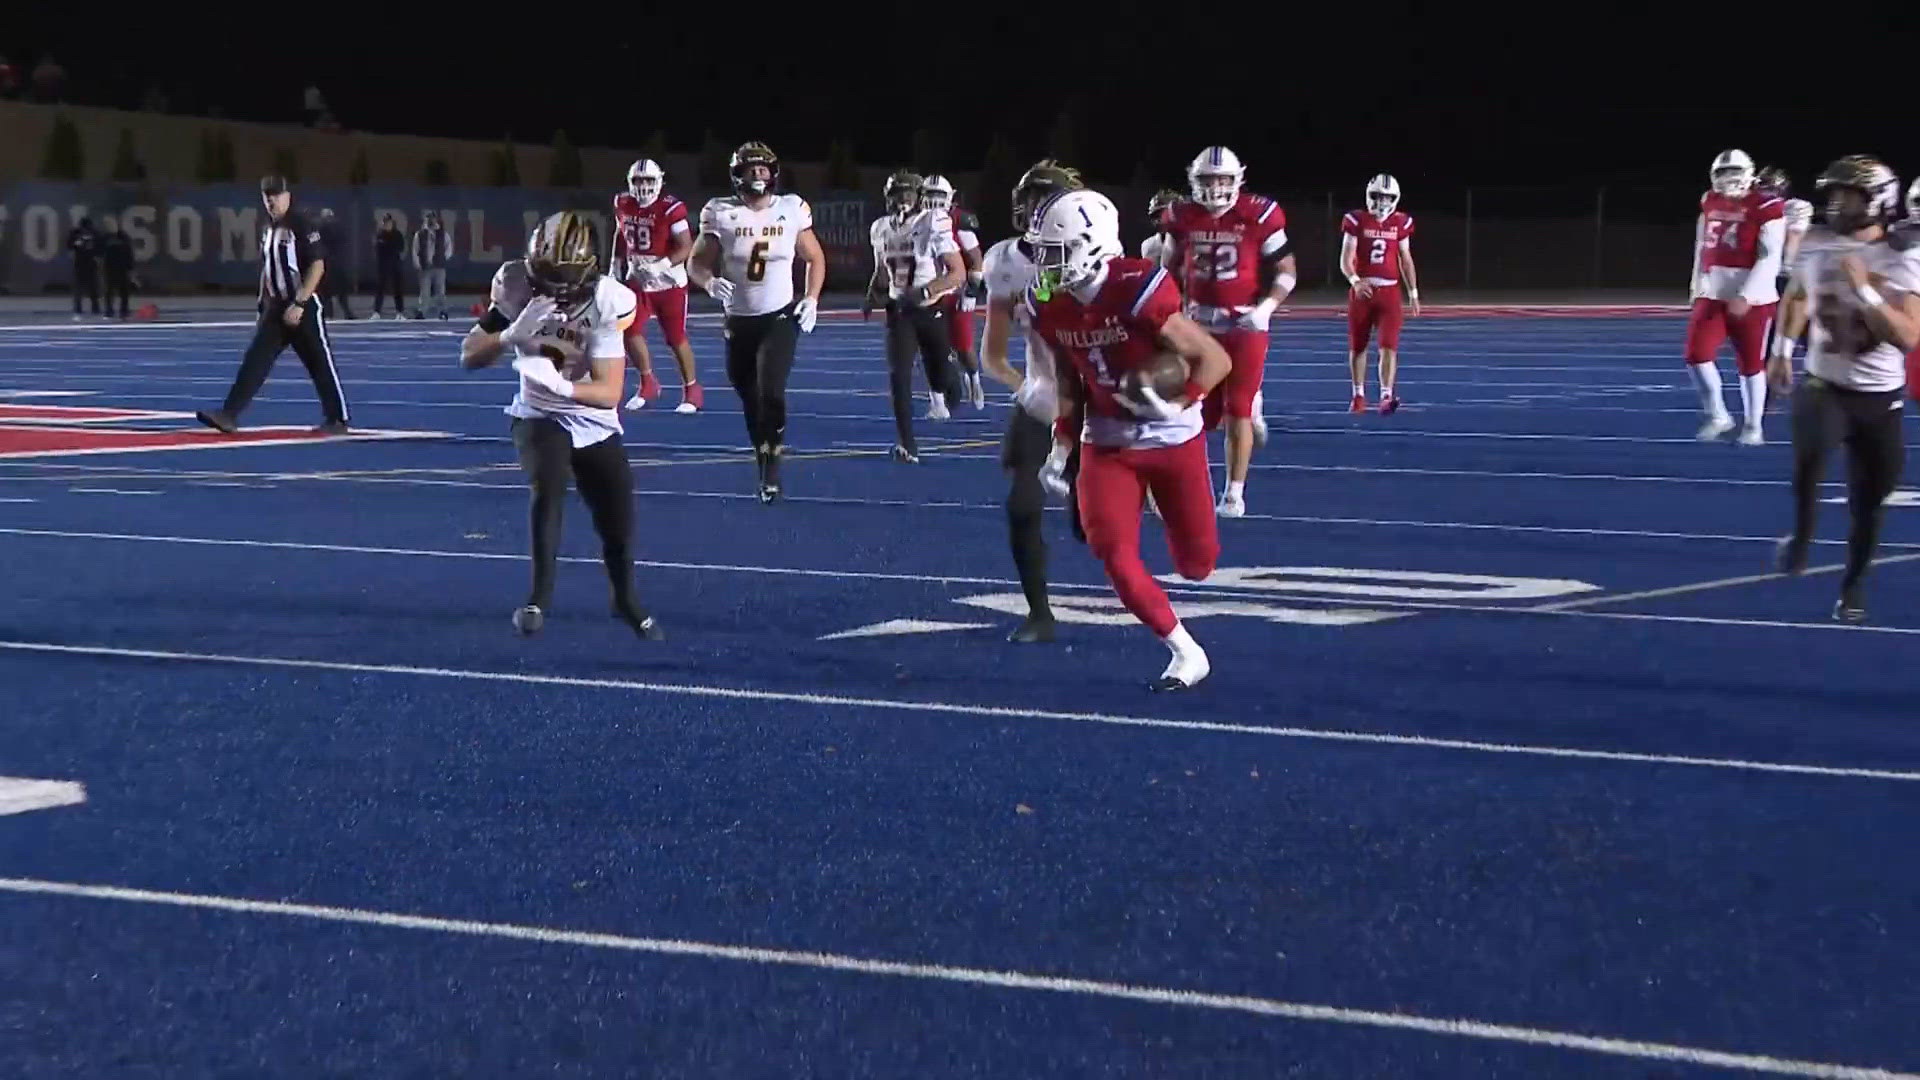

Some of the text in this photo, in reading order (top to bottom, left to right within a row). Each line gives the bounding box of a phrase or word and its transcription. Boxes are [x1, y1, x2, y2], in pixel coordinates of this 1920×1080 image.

[1077, 205, 1093, 228] 1
[0, 204, 260, 261] OSOM
[1704, 221, 1738, 249] 54
[747, 241, 770, 282] 6
[1192, 244, 1239, 280] 52
[1370, 238, 1387, 265] 2
[1055, 325, 1130, 348] BULLDOGS
